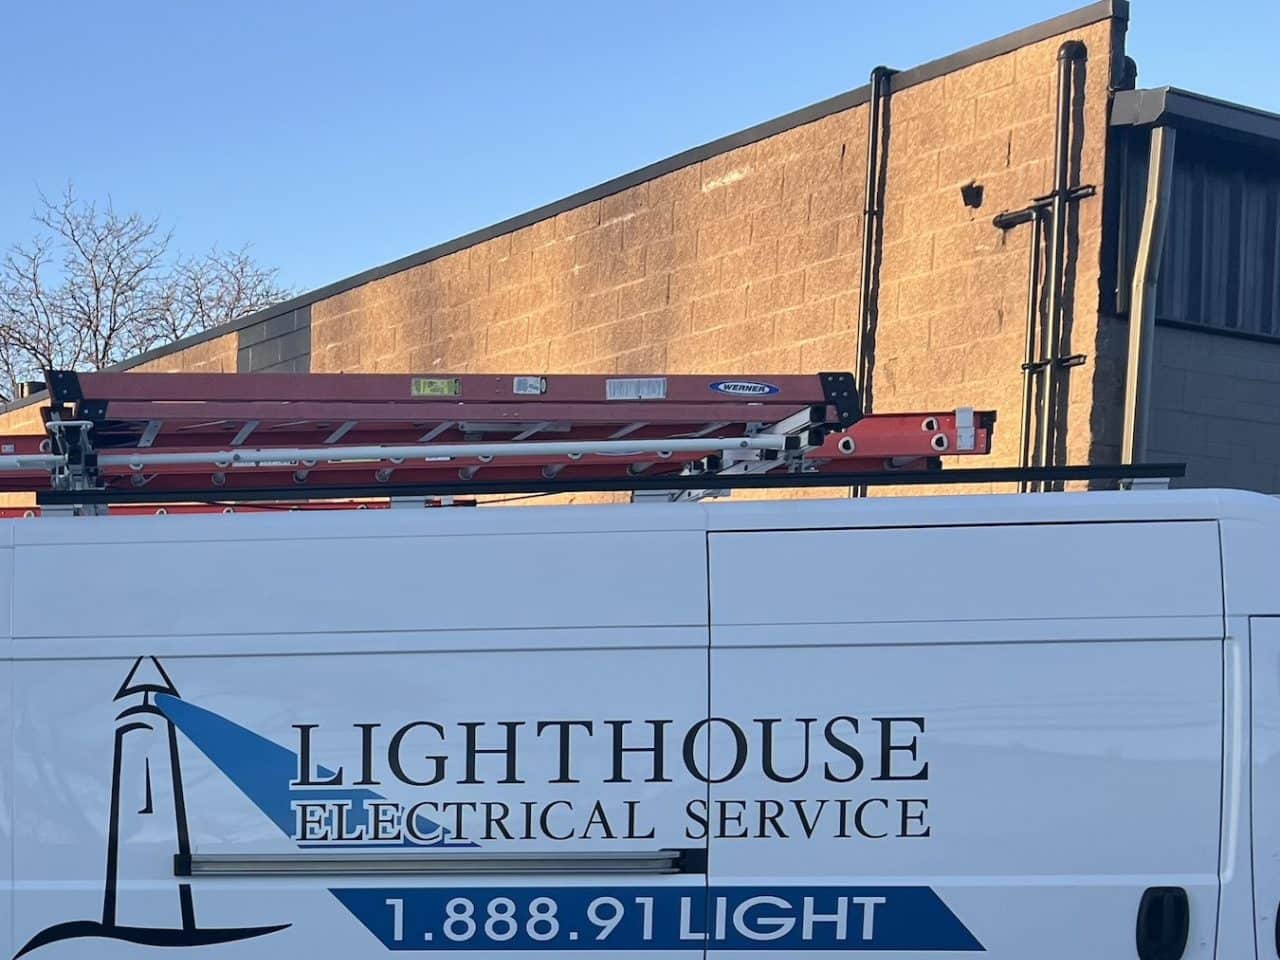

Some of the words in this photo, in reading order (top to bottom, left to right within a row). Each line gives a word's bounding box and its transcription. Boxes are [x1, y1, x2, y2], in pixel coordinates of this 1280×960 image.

[724, 383, 766, 393] WERNER
[291, 716, 929, 787] LIGHTHOUSE
[295, 800, 655, 841] ELECTRICAL
[685, 798, 931, 840] SERVICE
